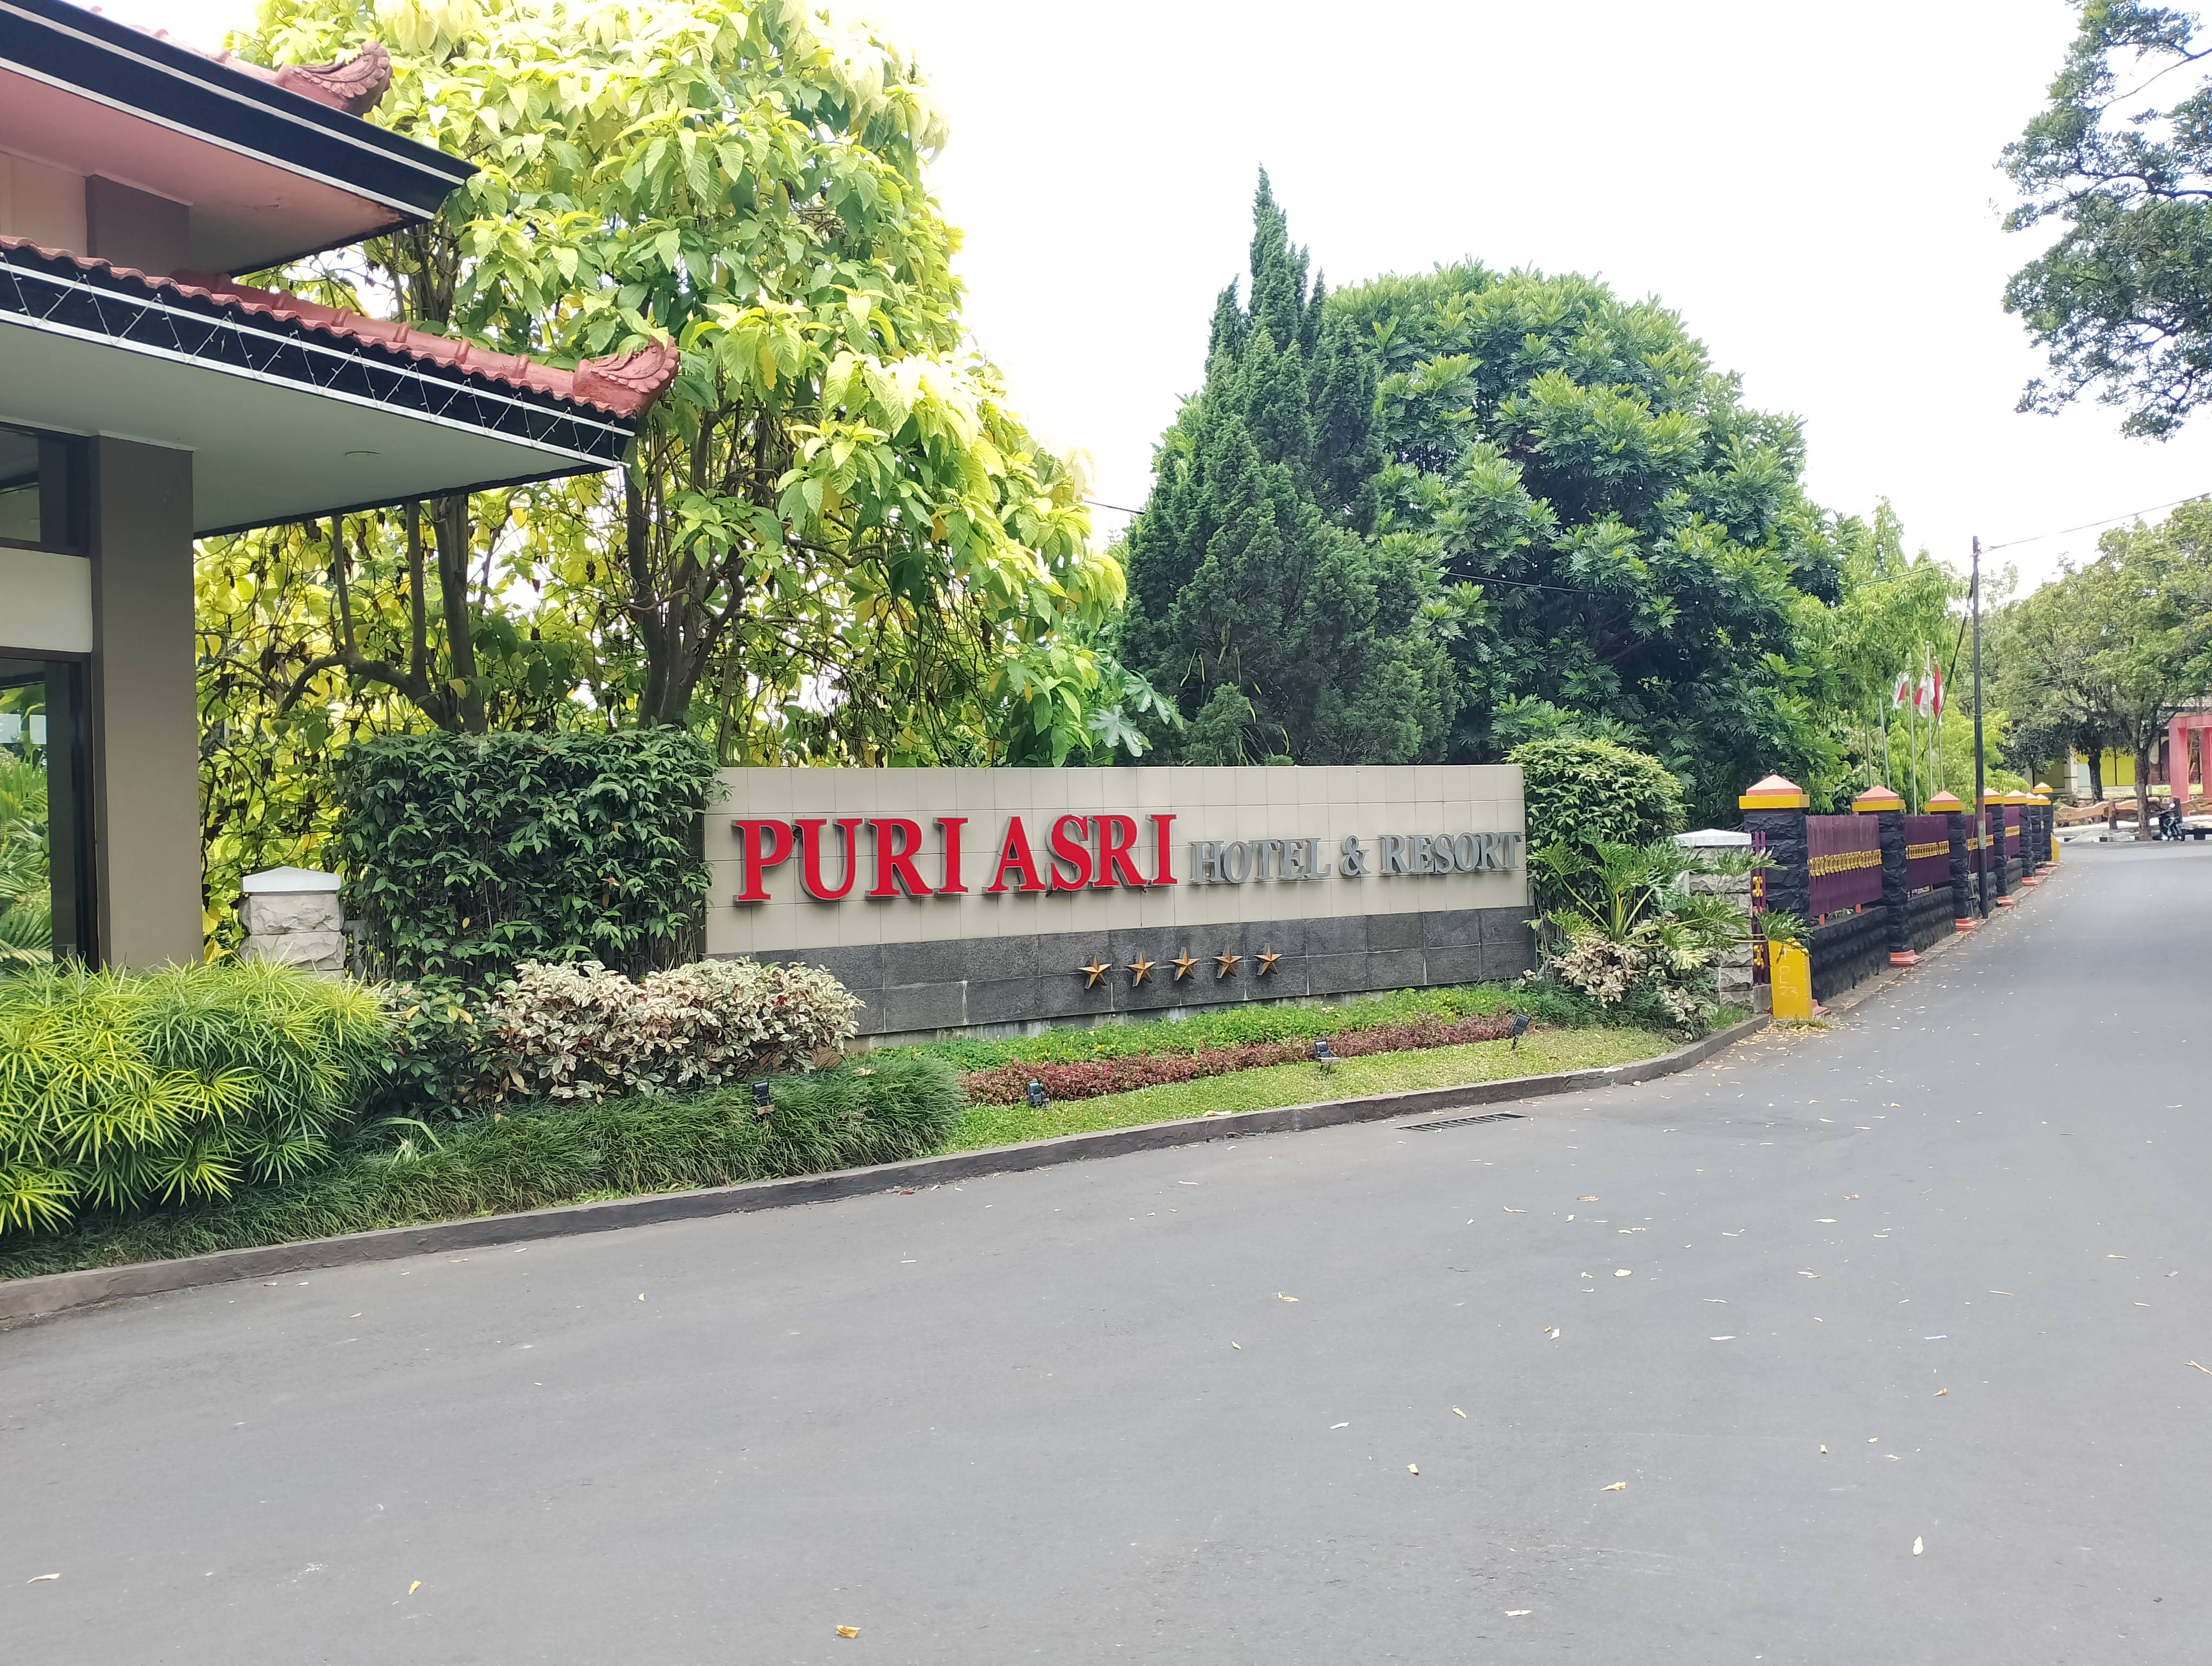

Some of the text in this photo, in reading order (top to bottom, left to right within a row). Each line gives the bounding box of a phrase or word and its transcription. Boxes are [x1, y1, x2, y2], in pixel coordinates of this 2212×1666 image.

[731, 813, 1522, 902] PURI ASRI HOTEL & RESORT
